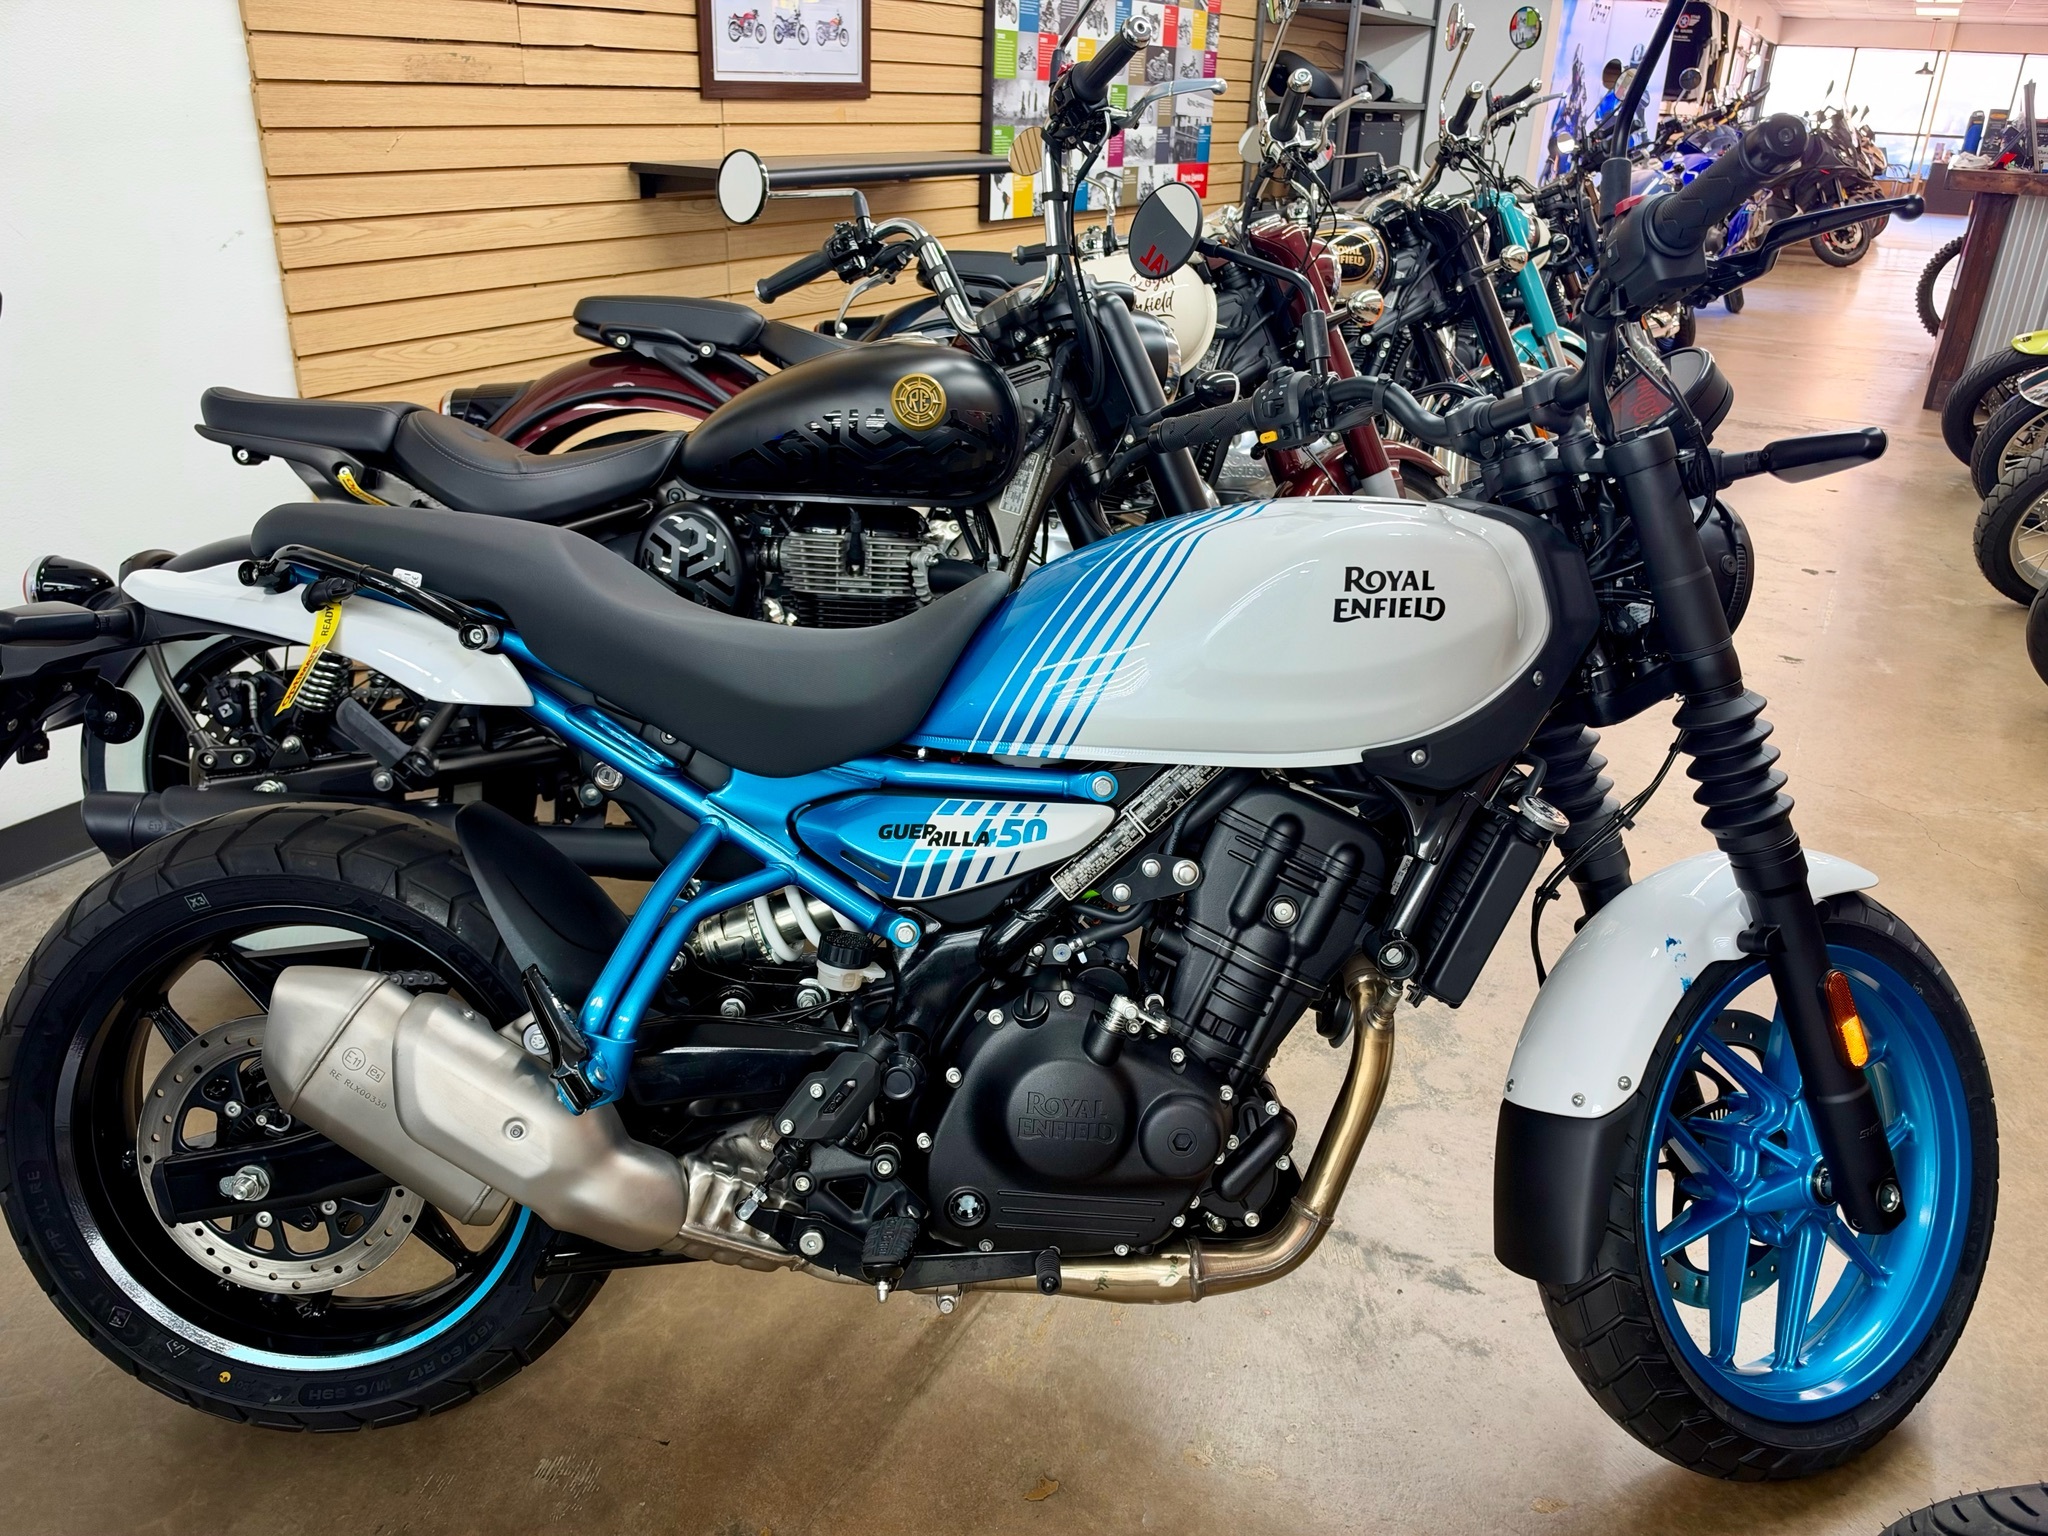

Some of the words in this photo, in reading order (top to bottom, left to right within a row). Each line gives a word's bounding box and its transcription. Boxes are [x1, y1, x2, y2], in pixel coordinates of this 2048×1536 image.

[1645, 7, 1663, 19] YZF-
[1339, 255, 1365, 267] FIELD
[1135, 291, 1175, 312] nfield
[1344, 566, 1436, 594] ROYAL
[1333, 597, 1446, 623] ENFIELD
[973, 818, 1048, 847] 450
[329, 1069, 343, 1081] RE
[1026, 1091, 1108, 1118] ROYAL
[1017, 1117, 1118, 1144] ENFIELD
